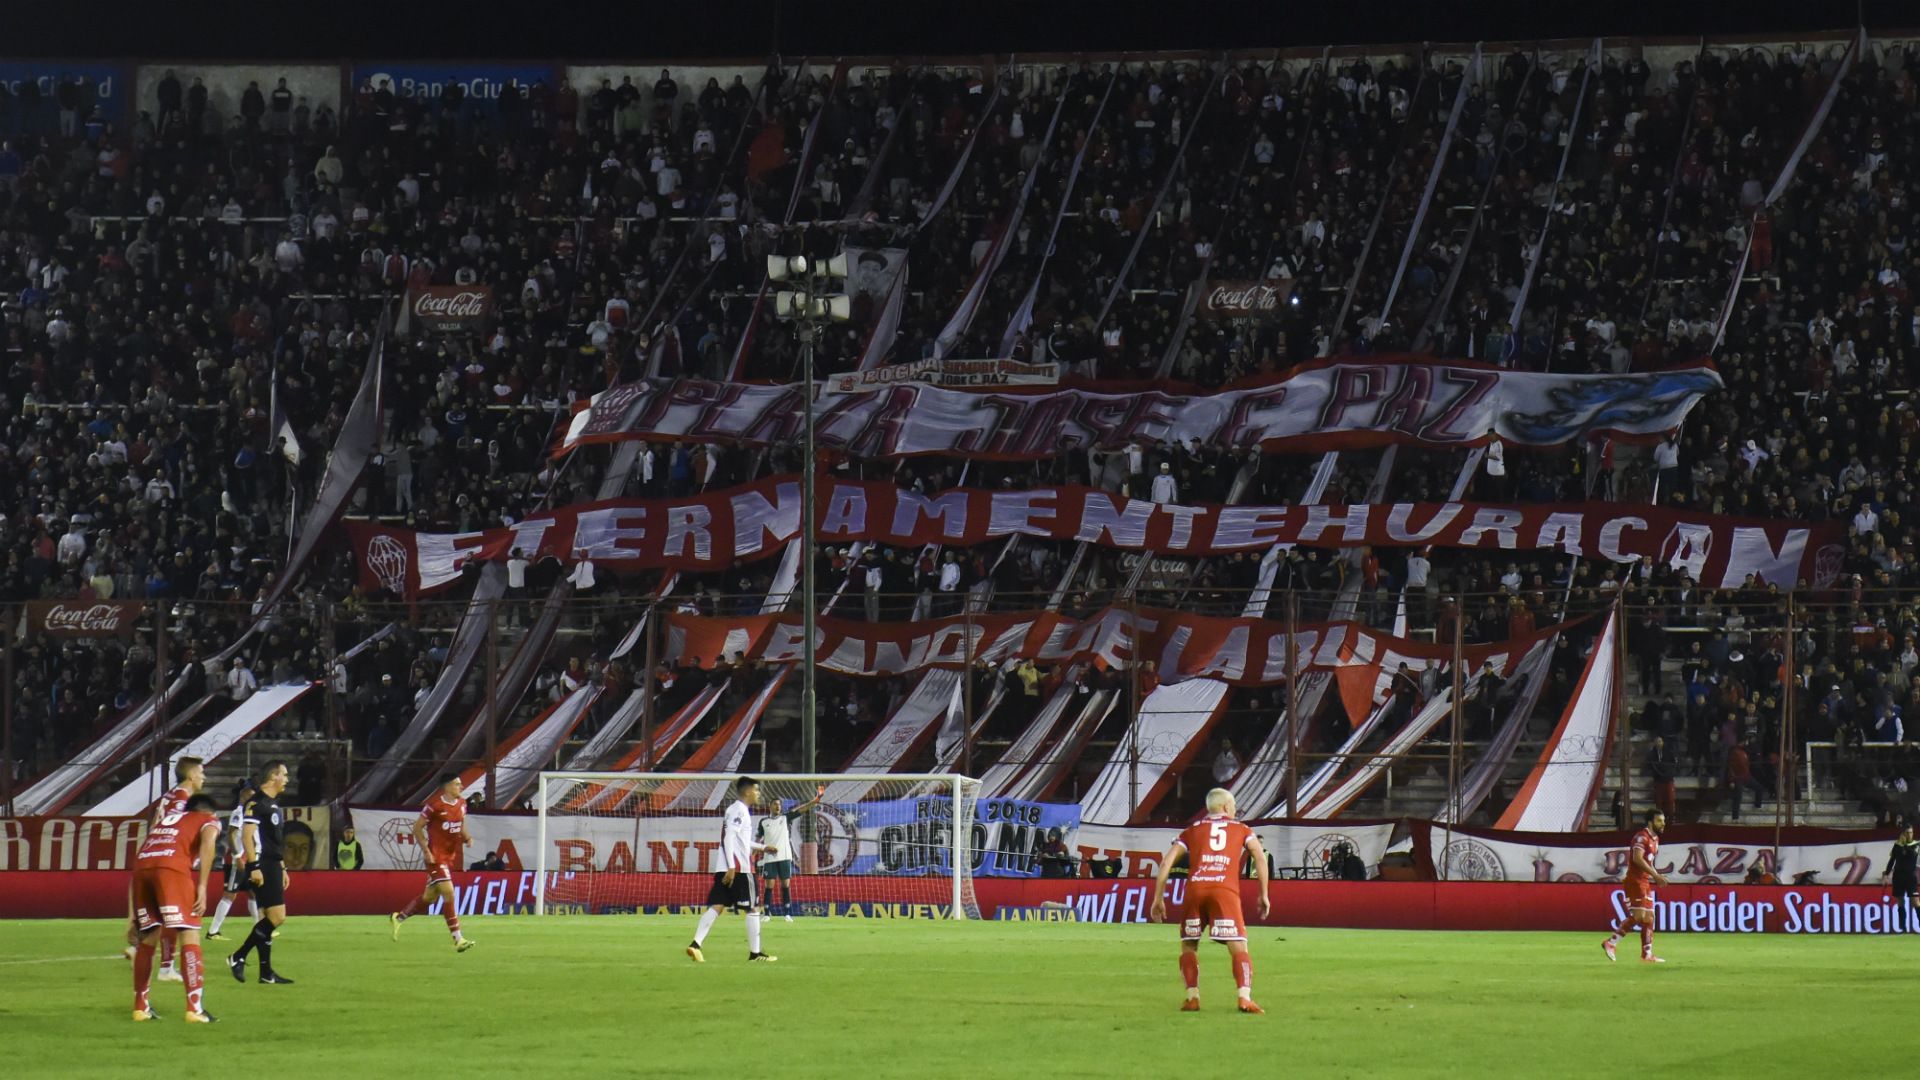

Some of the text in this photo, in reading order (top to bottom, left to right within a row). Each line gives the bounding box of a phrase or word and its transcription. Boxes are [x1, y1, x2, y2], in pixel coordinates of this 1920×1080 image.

[415, 292, 486, 316] Coca-Cola
[1208, 286, 1279, 310] Coca-Cla
[1317, 364, 1500, 443] PAZ
[45, 604, 121, 630] Coca-Cola
[916, 799, 1042, 825] RUSA 2018
[1209, 822, 1229, 851] 5
[554, 839, 722, 874] BAN
[1121, 886, 1148, 923] EL
[1611, 889, 1774, 933] Shneider
